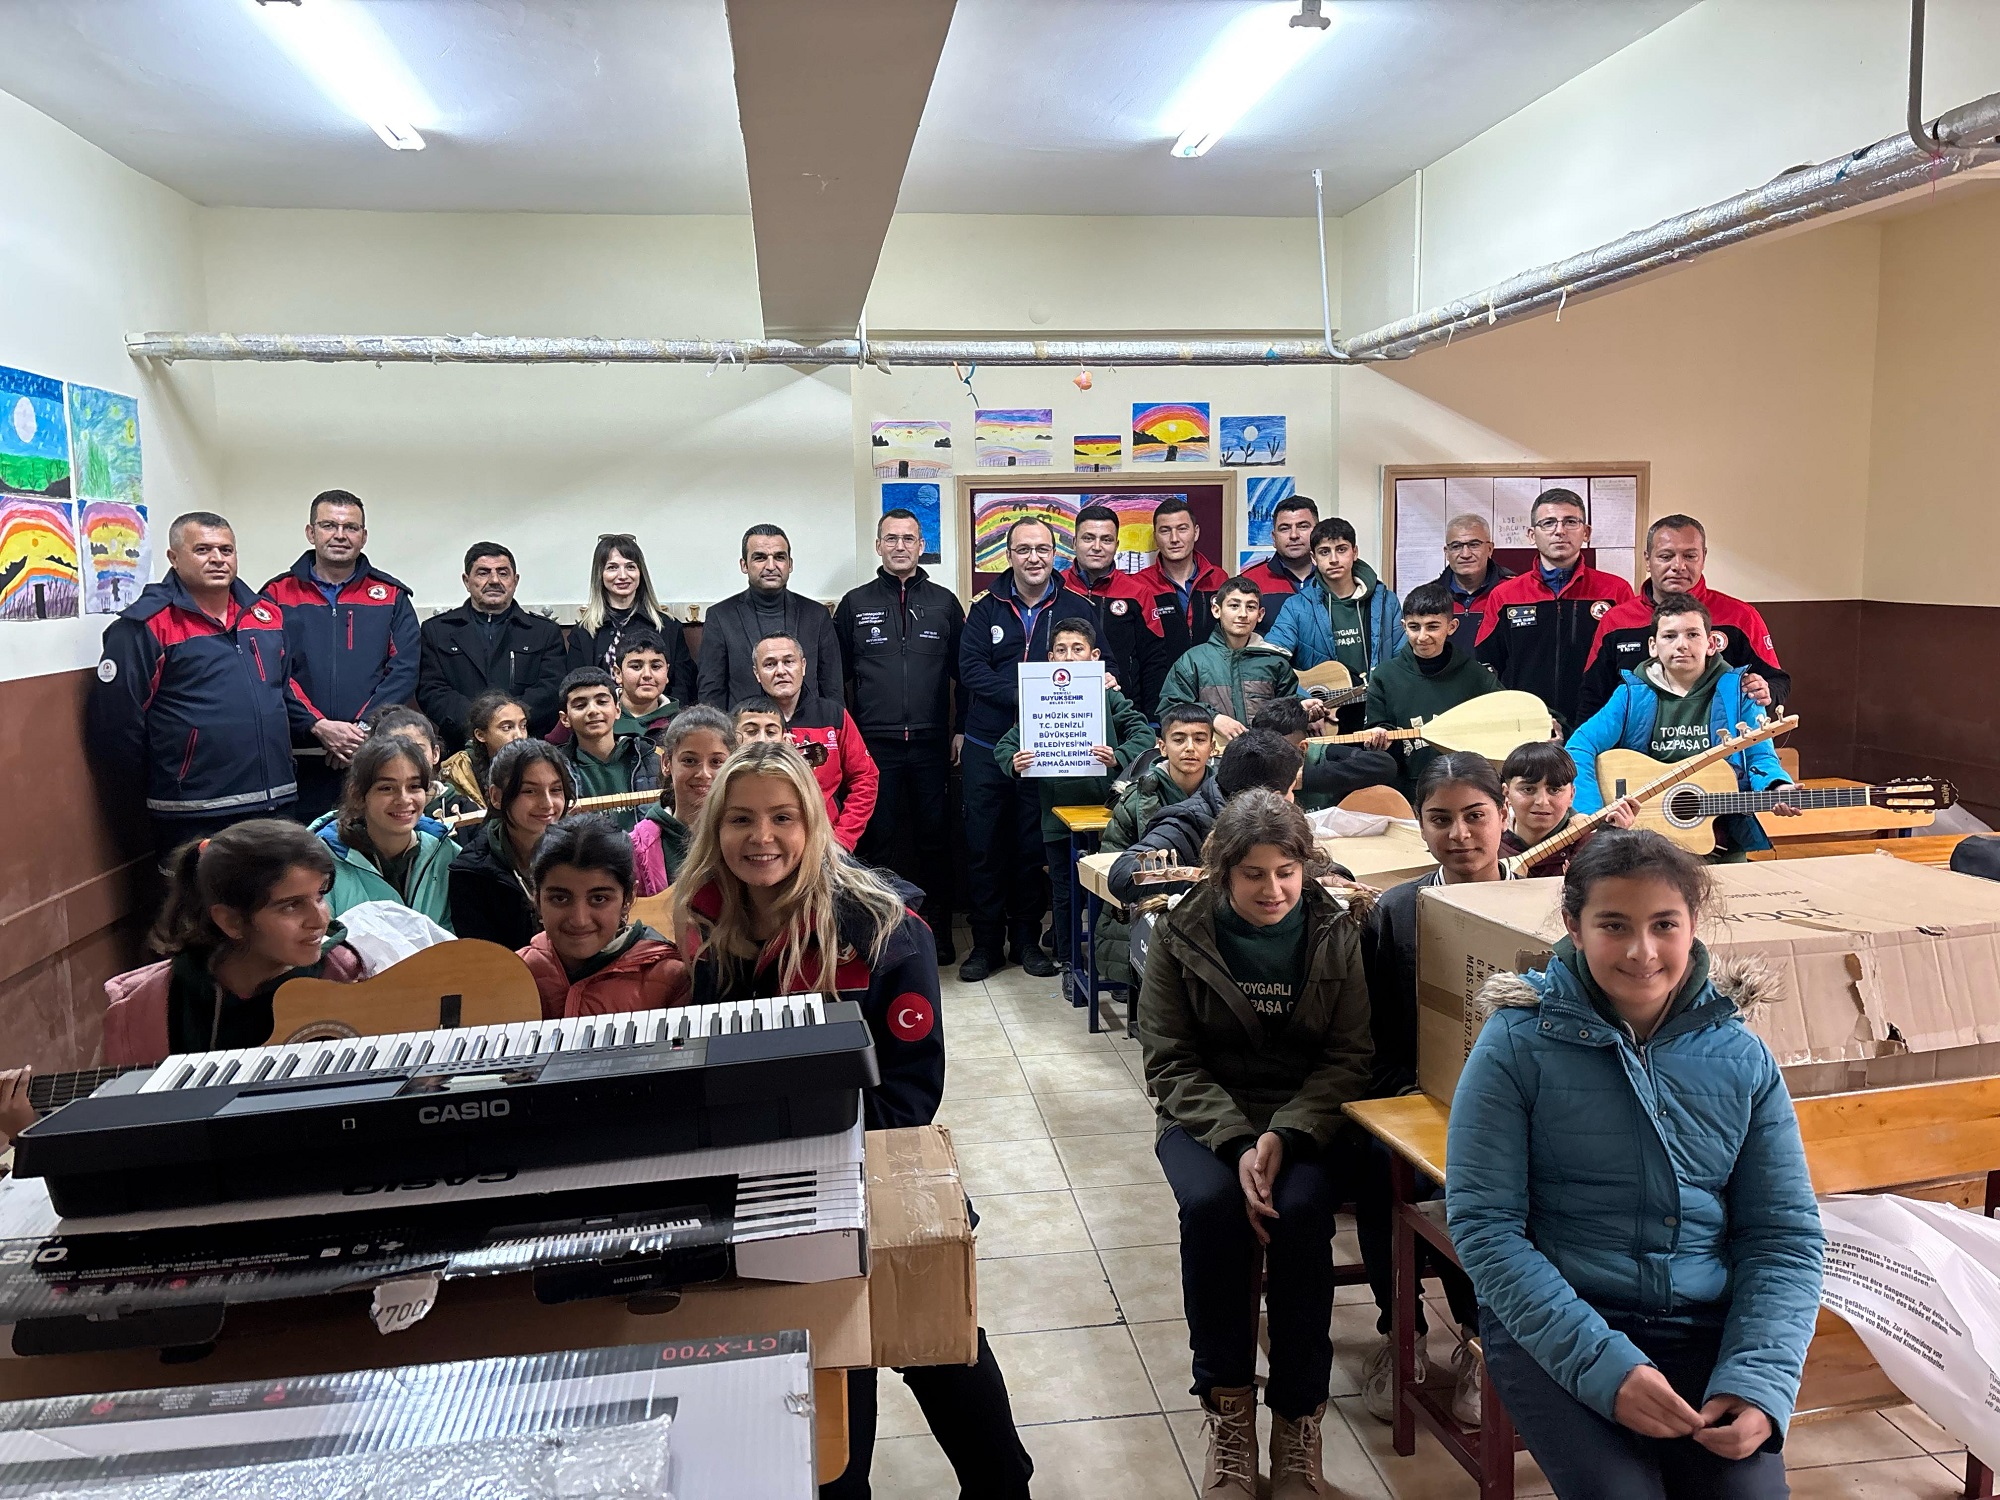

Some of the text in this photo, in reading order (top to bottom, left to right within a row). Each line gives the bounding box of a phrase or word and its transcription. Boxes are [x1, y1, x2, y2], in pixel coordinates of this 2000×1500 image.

[1054, 721, 1084, 729] DENİZLİ
[1039, 730, 1087, 739] BÜYÜKŞEHİR
[1702, 737, 1710, 748] O
[1033, 740, 1093, 748] BELEDİYESİ'NİN
[1035, 750, 1095, 758] ĞRENCİLERİMİZ
[1036, 759, 1091, 767] ARMAĞANIDIR
[419, 1099, 510, 1125] CASIO
[1841, 1248, 1859, 1258] from
[1860, 1253, 1884, 1268] babies
[1886, 1264, 1899, 1274] and
[1900, 1270, 1931, 1289] children.
[1893, 1260, 1912, 1272] avoid
[1862, 1283, 1873, 1292] sac
[1883, 1292, 1895, 1302] loin
[1896, 1298, 1907, 1309] des
[1870, 1277, 1883, 1288] être
[1919, 1301, 1932, 1313] Pour
[1825, 1297, 1843, 1309] diese
[1844, 1303, 1864, 1320] Tasche
[1865, 1317, 1876, 1326] von
[1876, 1321, 1892, 1337] Babys
[1892, 1332, 1902, 1343] und
[1903, 1338, 1921, 1355] Kindern
[1844, 1298, 1876, 1318] gefährlich
[1892, 1322, 1902, 1333] Zur
[1903, 1328, 1933, 1353] Vermeidung
[1933, 1348, 1943, 1359] von
[662, 1337, 777, 1361] CT-X700
